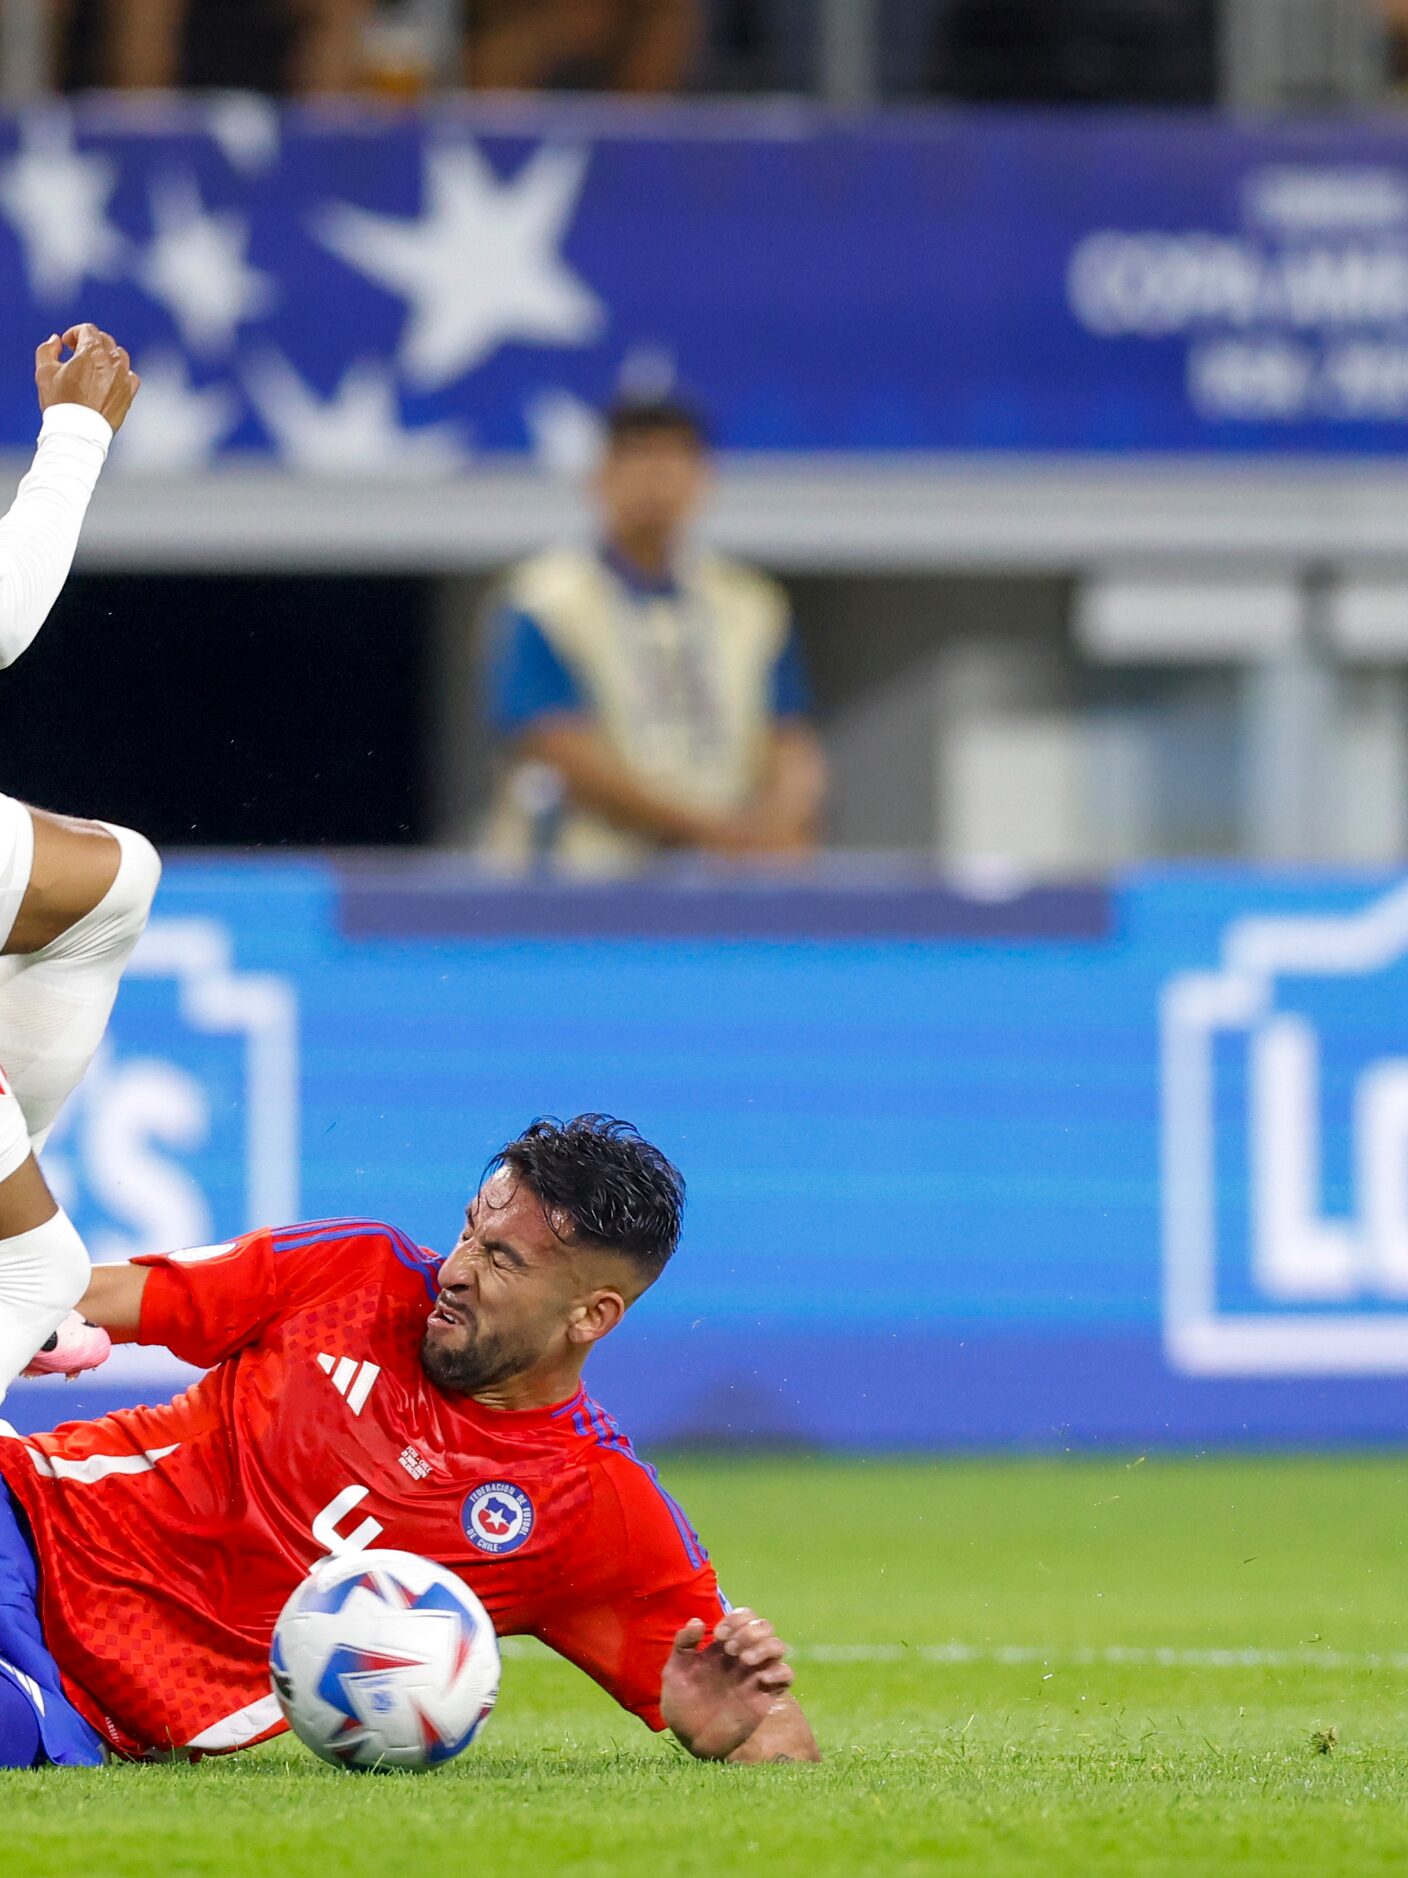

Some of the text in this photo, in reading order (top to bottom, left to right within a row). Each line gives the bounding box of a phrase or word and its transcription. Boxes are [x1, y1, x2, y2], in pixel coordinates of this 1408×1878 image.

[516, 1494, 528, 1506] DE
[466, 1528, 478, 1540] DE
[476, 1538, 500, 1552] CHILE
